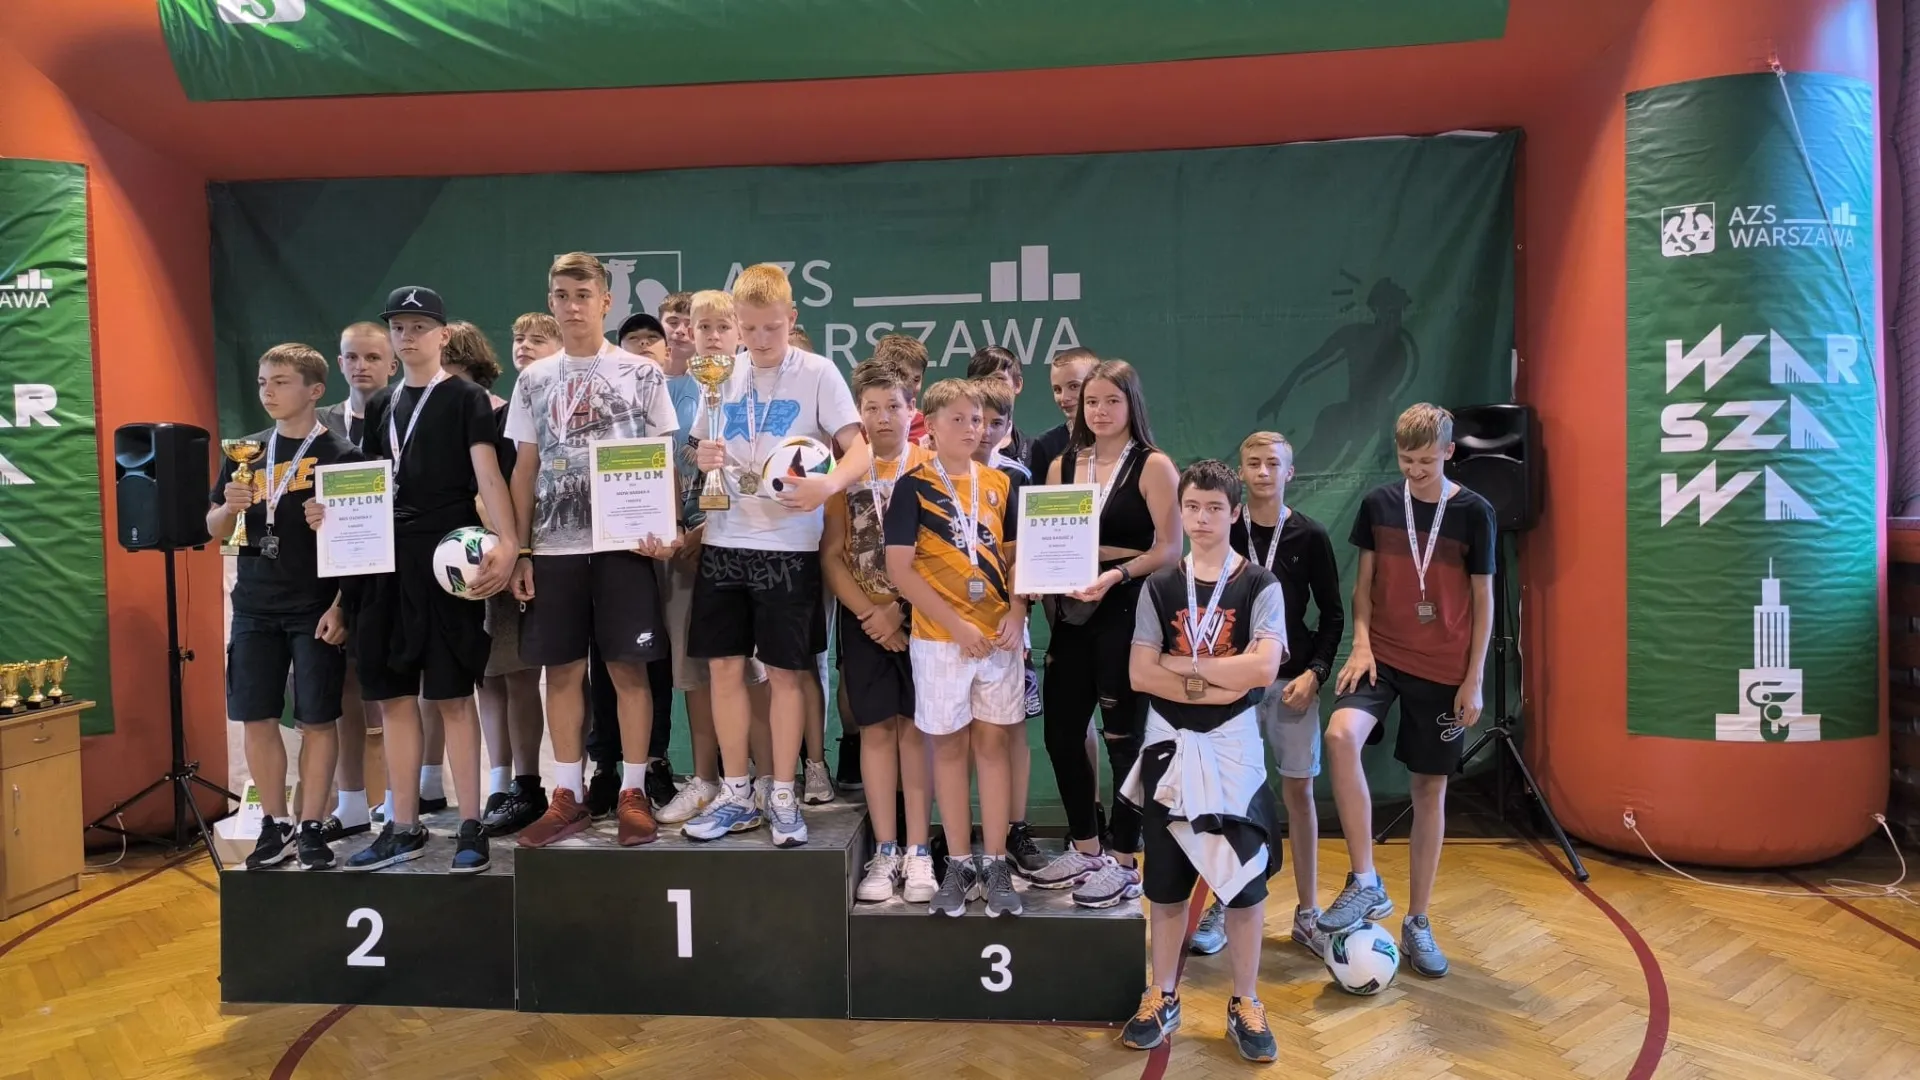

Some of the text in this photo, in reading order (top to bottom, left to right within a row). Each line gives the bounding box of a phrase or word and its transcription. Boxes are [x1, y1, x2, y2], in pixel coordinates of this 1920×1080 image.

[1728, 204, 1777, 226] AZS
[1728, 226, 1855, 248] WARSZAWA
[736, 316, 1081, 368] RSZAWA
[604, 470, 663, 482] DYPLOM
[329, 495, 384, 507] DYPLOM
[1030, 516, 1089, 527] DYPLOM
[667, 889, 693, 957] 1
[346, 907, 386, 967] 2
[980, 944, 1013, 992] 3
